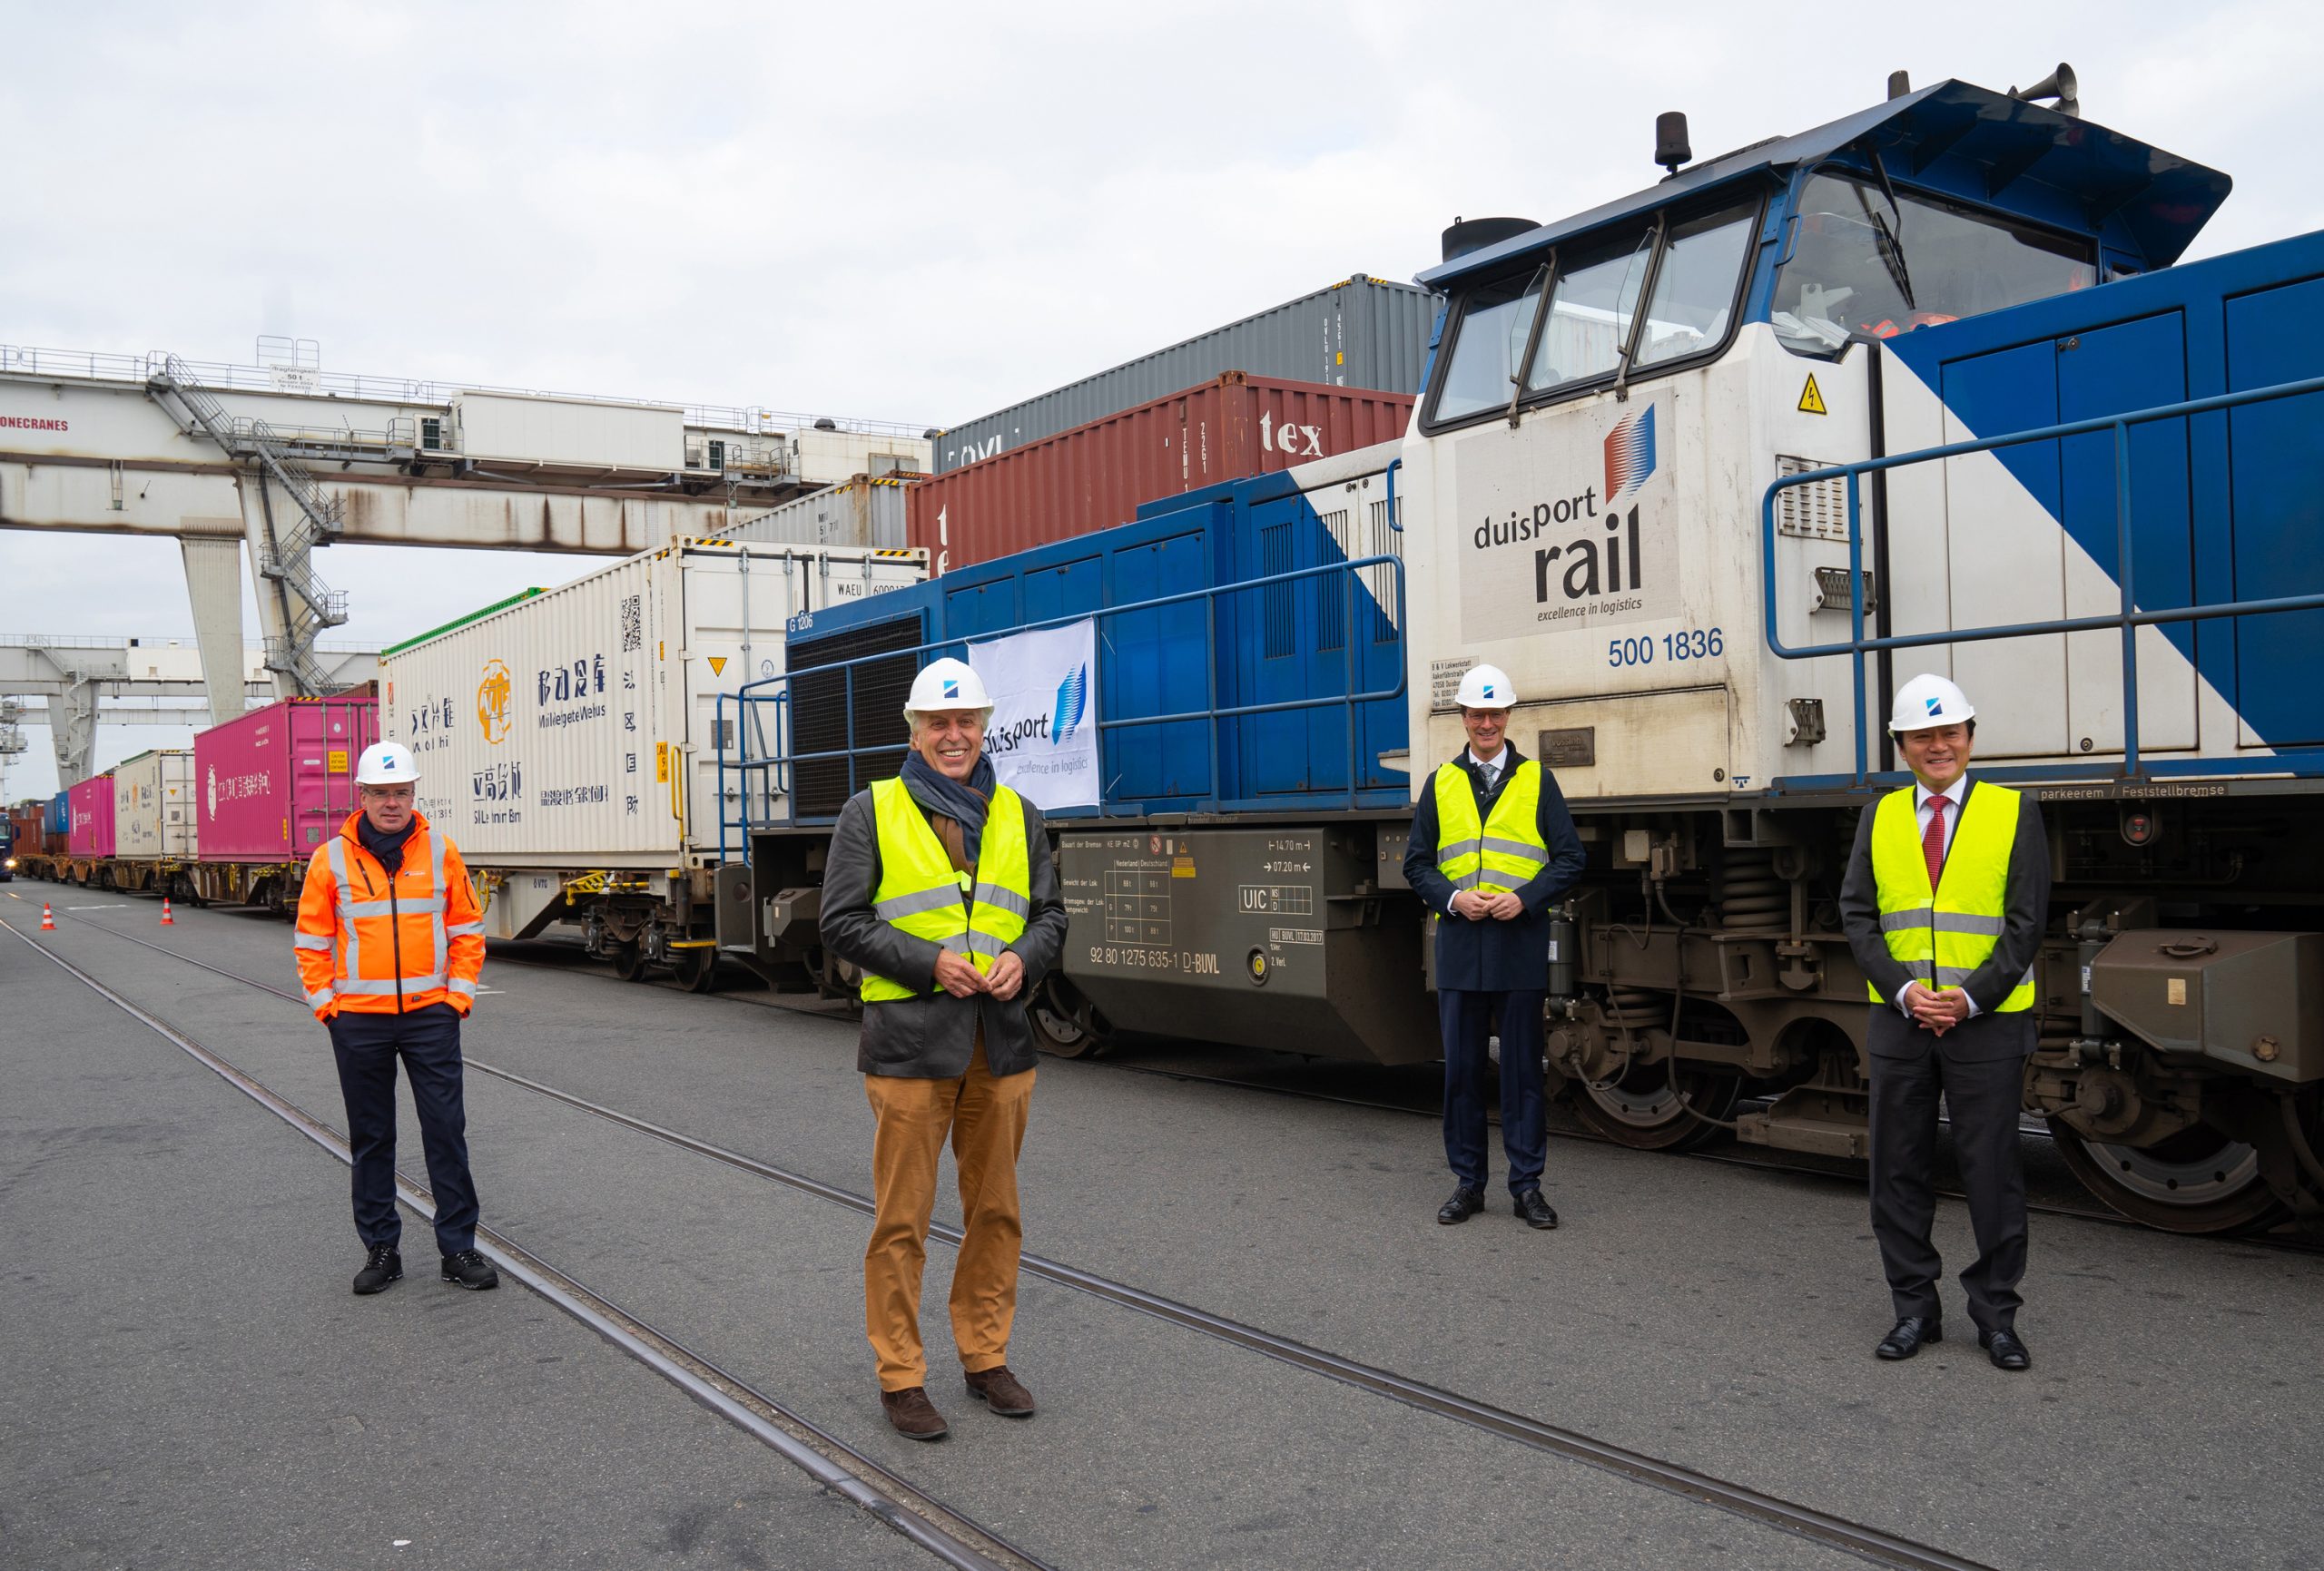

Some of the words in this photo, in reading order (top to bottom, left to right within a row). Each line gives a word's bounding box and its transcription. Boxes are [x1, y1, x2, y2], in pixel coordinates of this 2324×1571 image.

[1260, 409, 1324, 457] tex
[1474, 485, 1598, 549] duisport
[1535, 503, 1641, 604] rail
[837, 584, 862, 596] WAEU
[1537, 605, 1586, 622] excellence
[1588, 603, 1598, 615] in
[1600, 597, 1642, 615] logistics
[789, 619, 795, 633] G
[797, 614, 813, 631] 1206
[1610, 634, 1653, 668] 500
[1662, 626, 1724, 662] 1836
[1051, 761, 1059, 773] in
[2122, 784, 2224, 798] Feststellbremse
[1276, 840, 1294, 850] 14.70
[1140, 859, 1167, 868] Deutschland
[1273, 861, 1293, 872] 07.20
[1294, 864, 1301, 872] m
[1244, 889, 1266, 909] UIC
[1271, 889, 1278, 898] NS
[1273, 901, 1278, 911] D
[1281, 930, 1295, 941] BUVL
[1090, 947, 1103, 963] 92
[1105, 948, 1118, 965] 80
[1121, 949, 1147, 967] 1275
[1148, 950, 1178, 968] 635-1
[1183, 952, 1220, 974] D-BUVL
